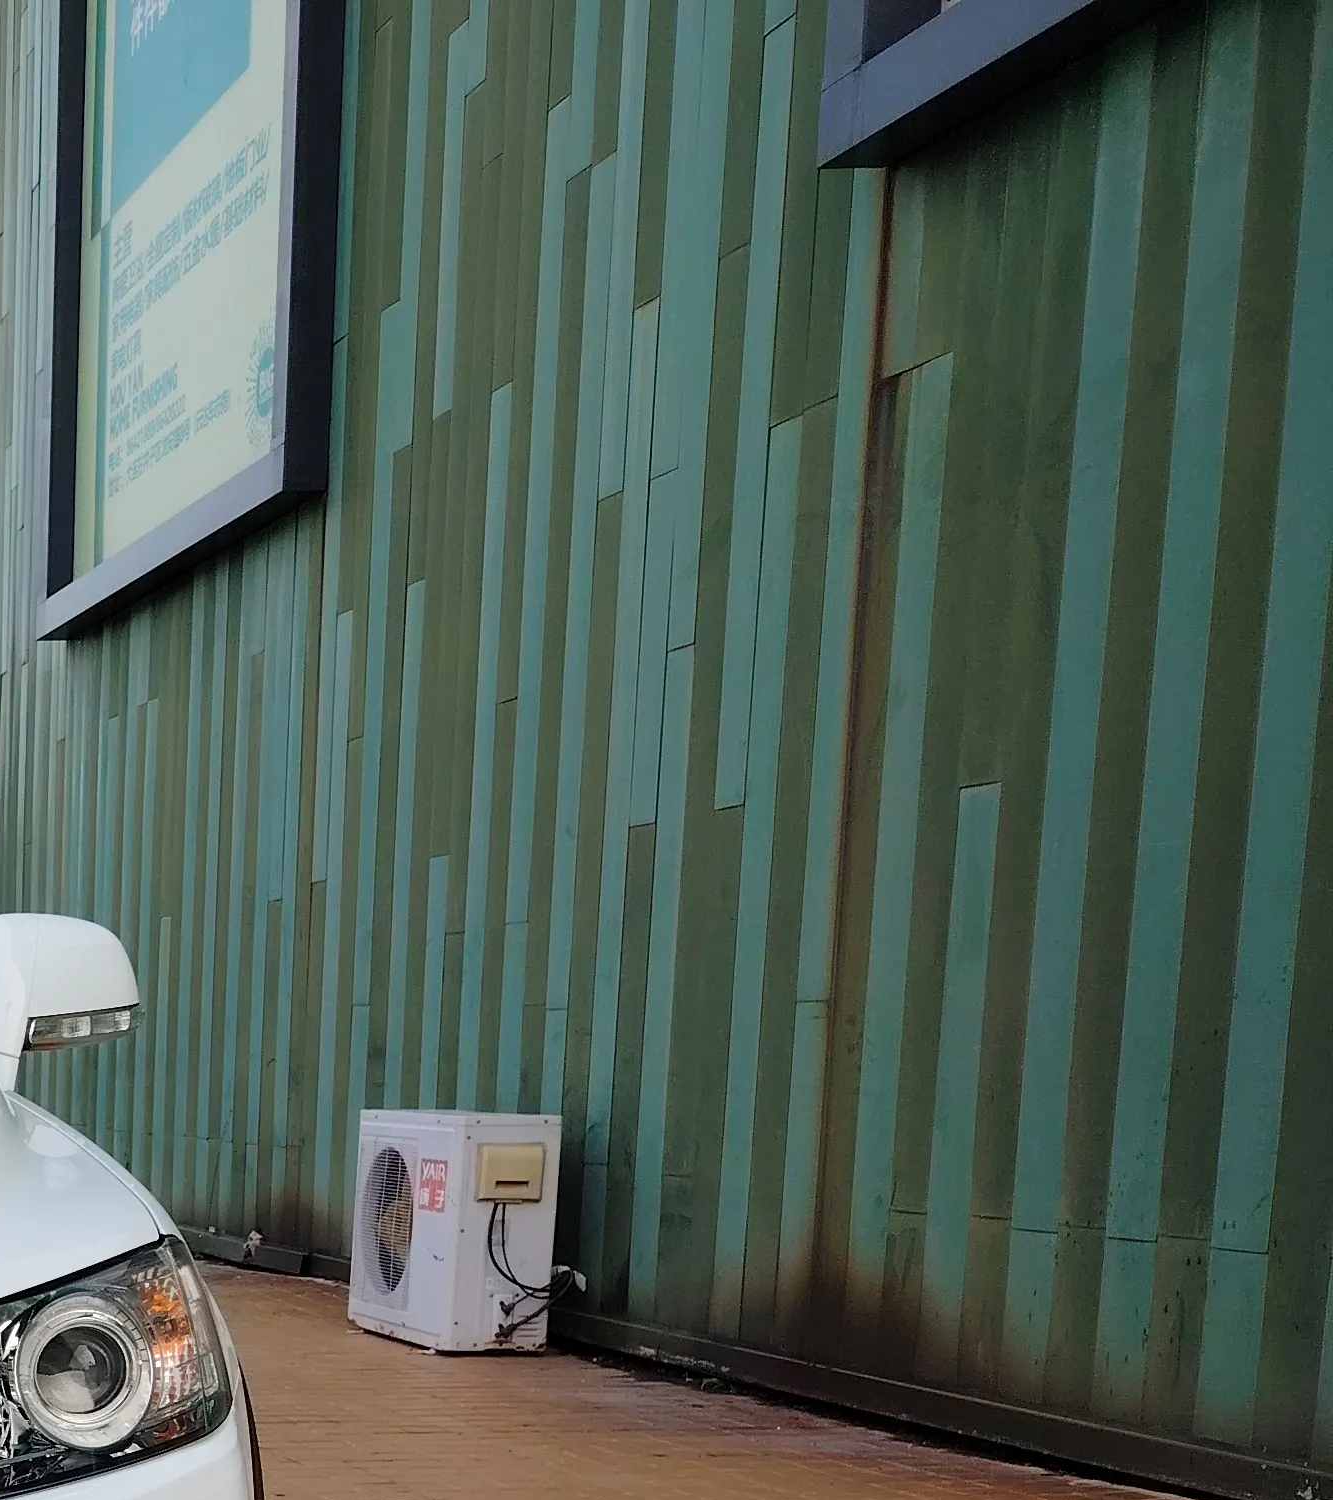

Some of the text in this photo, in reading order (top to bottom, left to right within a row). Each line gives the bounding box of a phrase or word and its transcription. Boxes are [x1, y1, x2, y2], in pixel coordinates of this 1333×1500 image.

[113, 220, 133, 270] 主营
[109, 403, 131, 443] HOME
[132, 362, 178, 425] FURNISHING
[422, 1161, 446, 1181] YAIR
